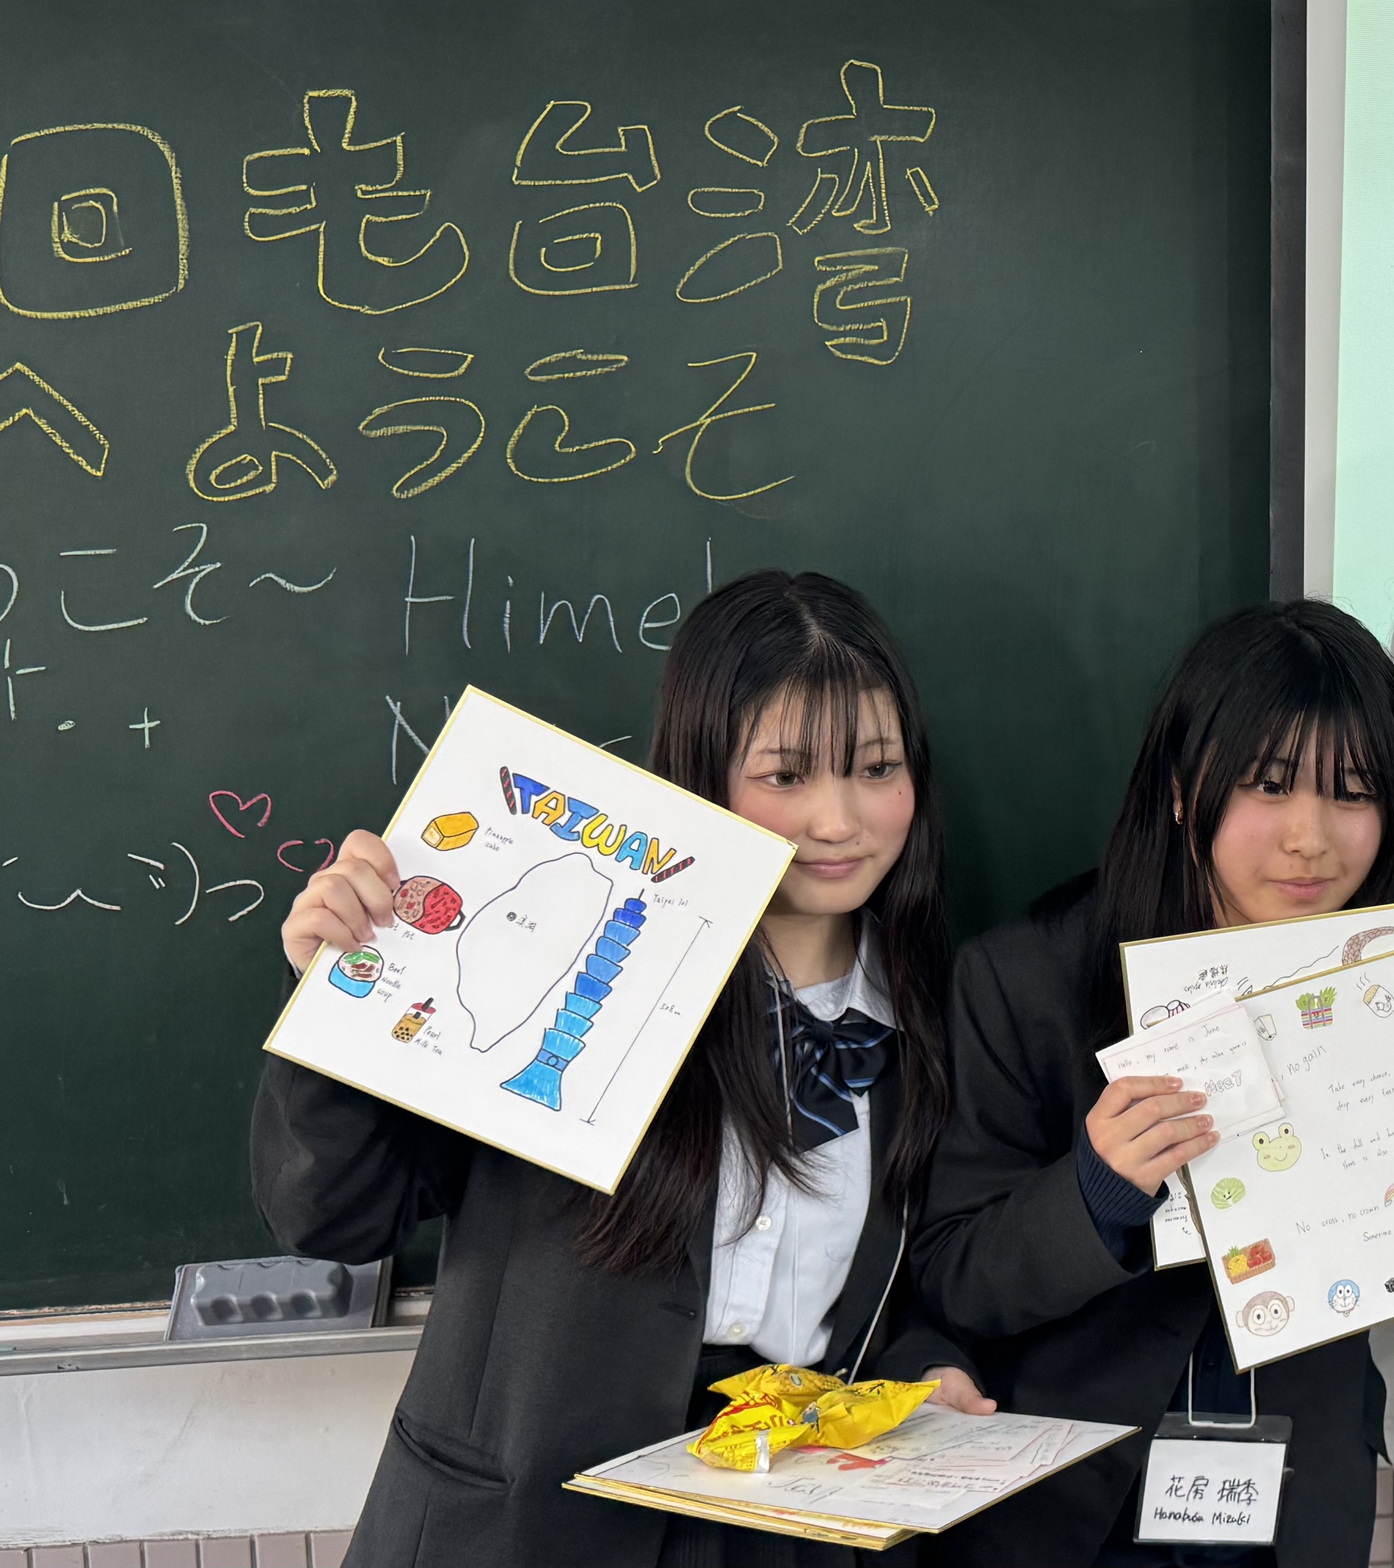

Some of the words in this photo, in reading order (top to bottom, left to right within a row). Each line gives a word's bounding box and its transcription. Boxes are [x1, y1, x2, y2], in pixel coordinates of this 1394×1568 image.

[512, 773, 676, 874] TAIWAN
[388, 963, 406, 975] Beef
[423, 1025, 441, 1040] Pearl
[1286, 1063, 1300, 1075] no
[1303, 1045, 1327, 1072] gain
[1328, 1083, 1345, 1094] Take
[1320, 1148, 1331, 1160] In
[1370, 1132, 1381, 1144] and
[1377, 1149, 1388, 1157] also
[1295, 1220, 1311, 1235] No
[1347, 1212, 1357, 1221] no
[1360, 1205, 1380, 1217] crown
[1211, 1512, 1251, 1526] Mizuki
